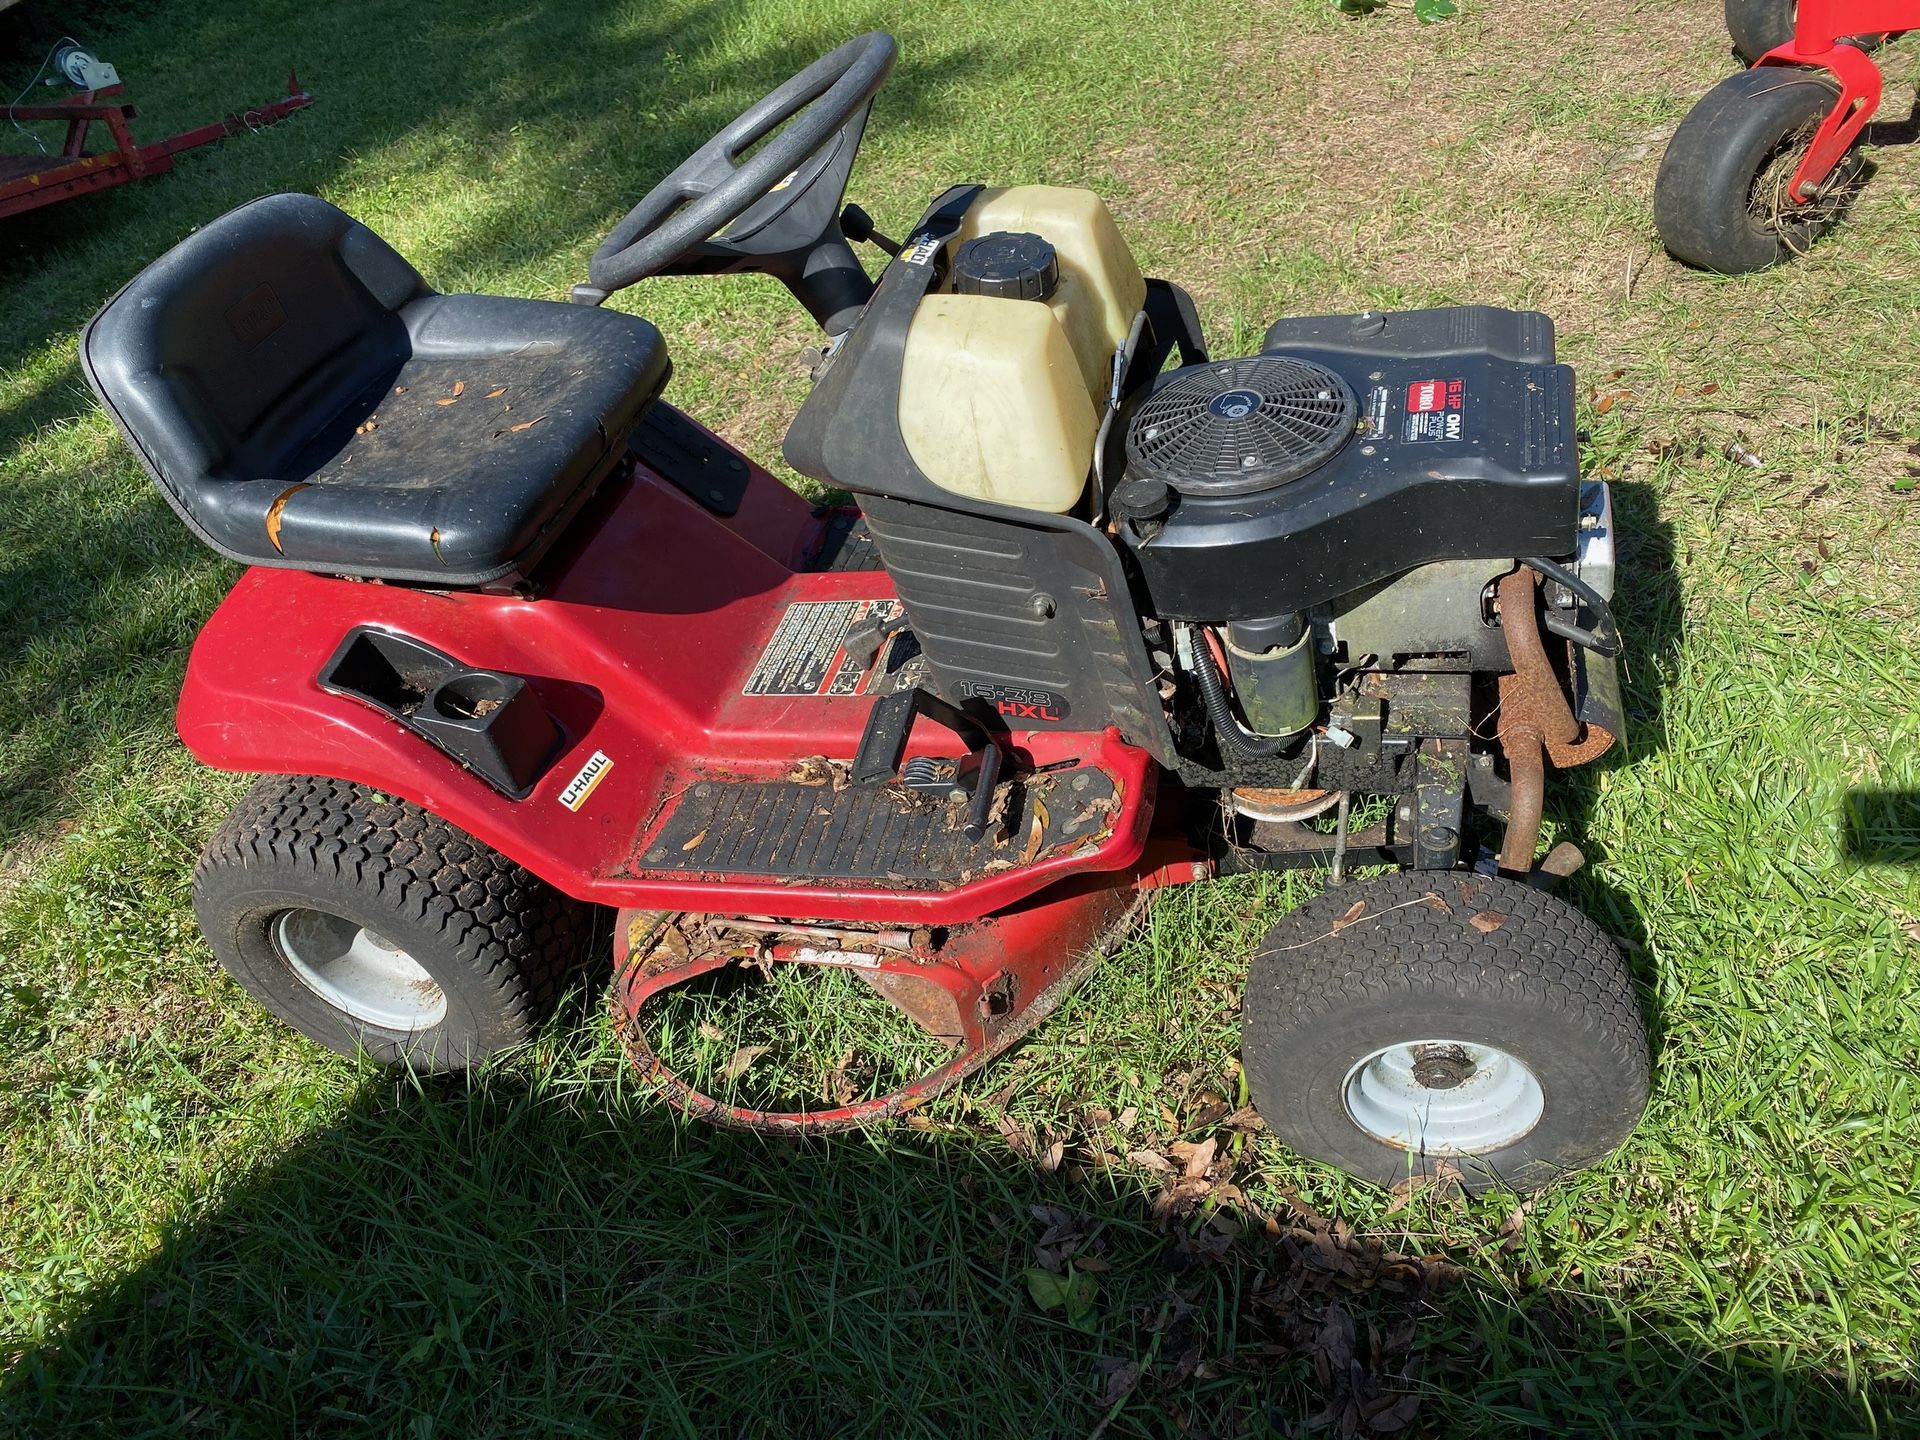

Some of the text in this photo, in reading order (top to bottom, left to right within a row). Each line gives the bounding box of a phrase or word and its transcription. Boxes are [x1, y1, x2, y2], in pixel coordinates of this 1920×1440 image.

[1419, 383, 1434, 410] TORO
[1445, 379, 1462, 439] 16 HP OHV
[1428, 416, 1437, 436] PLUS
[1435, 411, 1445, 440] POWER
[960, 680, 1051, 707] 16-38
[997, 701, 1059, 721] HXL
